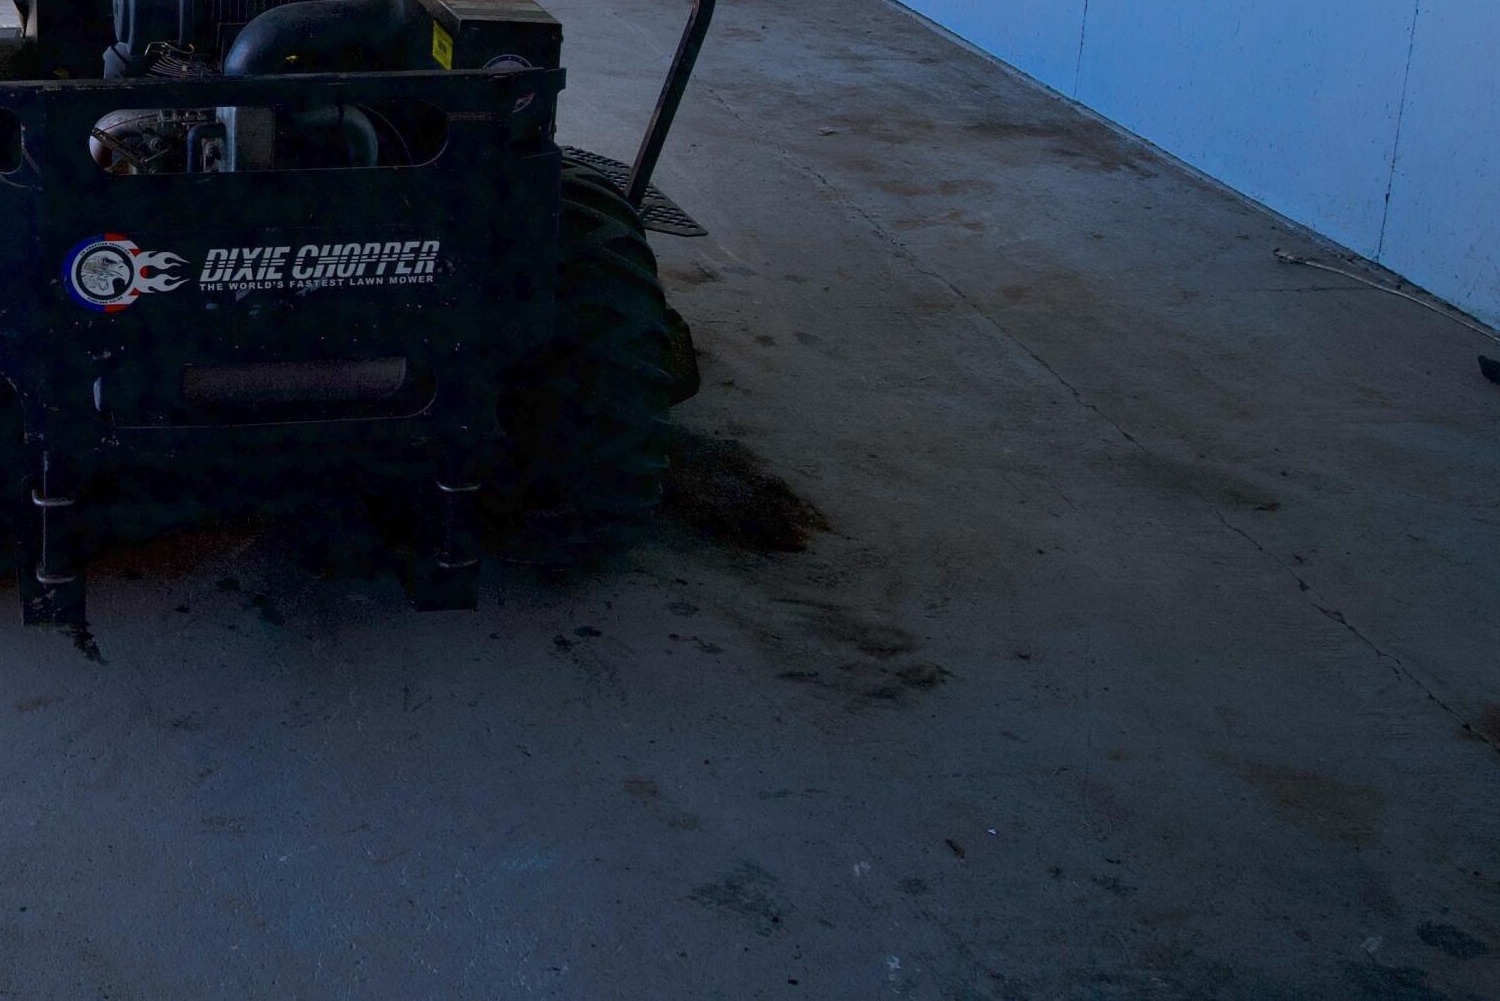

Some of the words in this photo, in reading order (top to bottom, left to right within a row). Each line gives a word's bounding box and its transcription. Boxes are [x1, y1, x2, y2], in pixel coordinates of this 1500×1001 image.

[199, 246, 291, 282] DIXIE
[291, 240, 440, 281] CHOPPER
[199, 283, 224, 291] THE
[228, 281, 284, 290] WORLD'S
[289, 279, 345, 288] FASTEST
[349, 276, 384, 286] LAWN
[389, 275, 434, 285] MOWER
